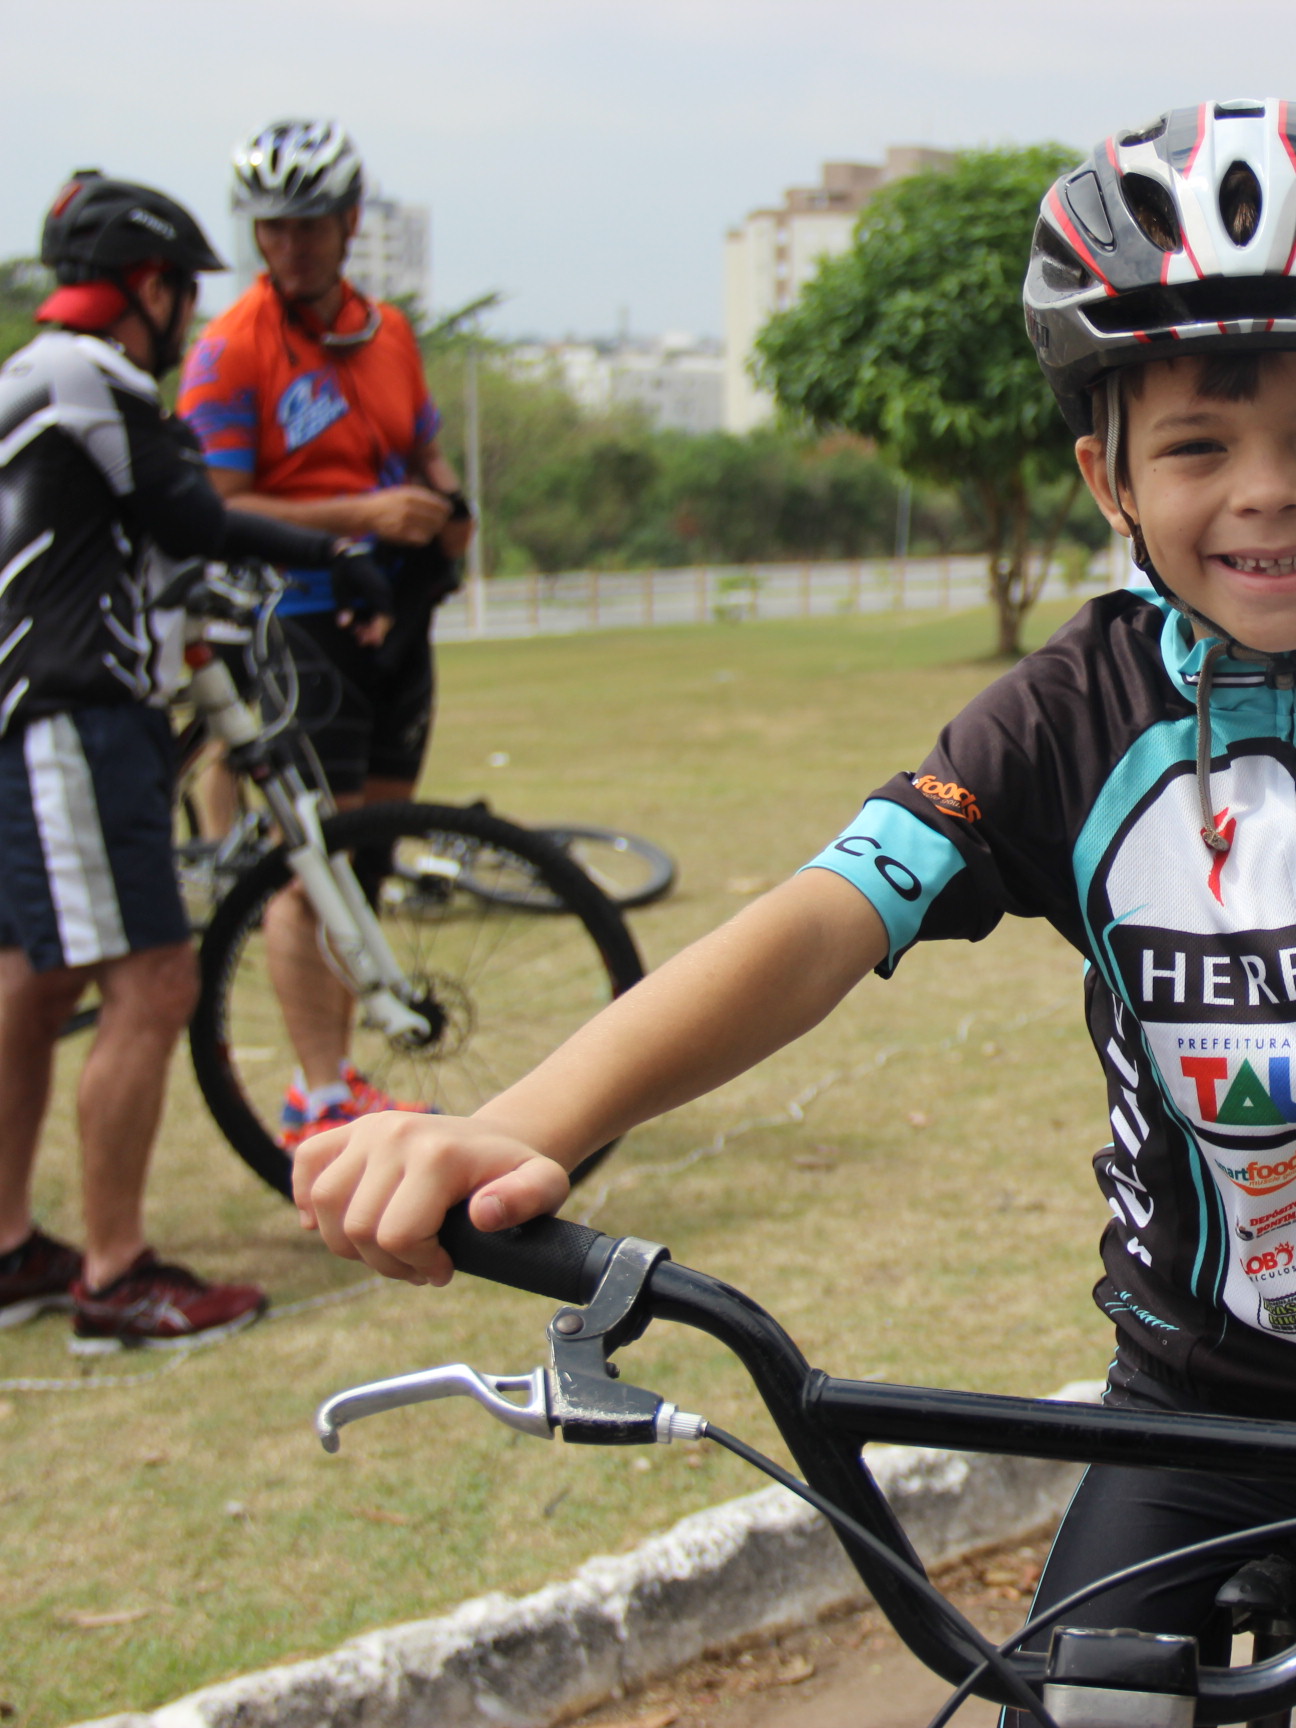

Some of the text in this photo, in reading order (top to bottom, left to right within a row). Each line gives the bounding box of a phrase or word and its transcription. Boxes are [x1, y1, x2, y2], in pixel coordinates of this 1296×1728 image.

[910, 774, 982, 824] foods
[834, 835, 923, 902] CO
[1177, 1035, 1292, 1050] PREFEITURA
